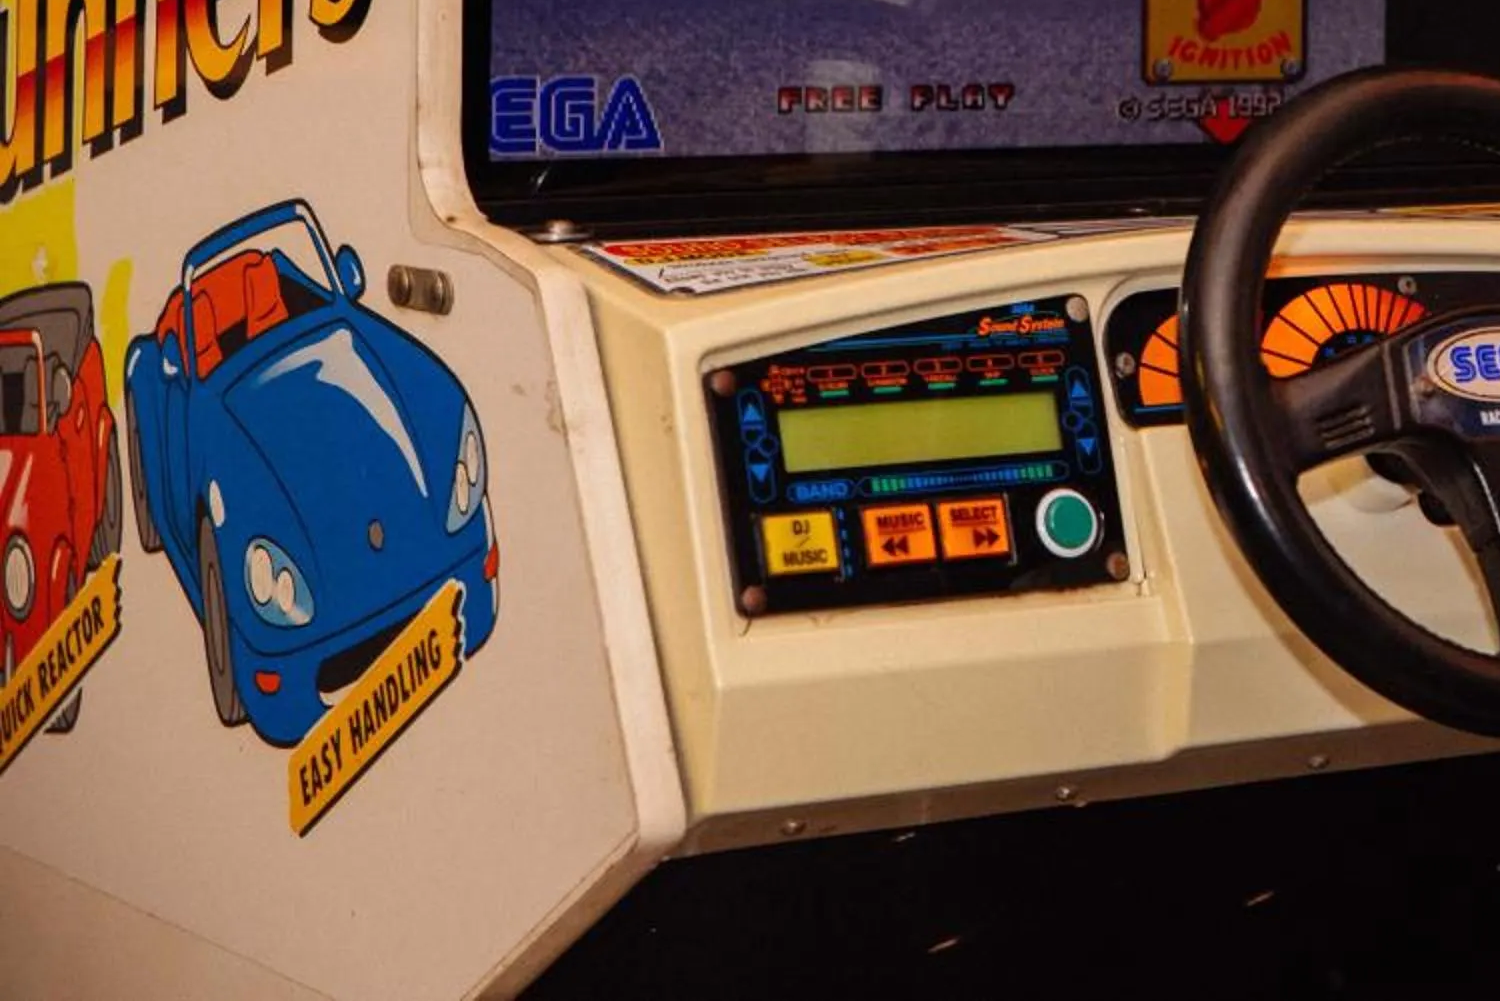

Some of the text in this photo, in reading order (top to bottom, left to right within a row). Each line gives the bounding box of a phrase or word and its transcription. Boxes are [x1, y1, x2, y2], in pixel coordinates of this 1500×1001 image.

[1166, 30, 1292, 72] IGNITION
[776, 82, 1017, 114] FREE PLAY
[977, 316, 1018, 337] Sound
[795, 481, 847, 499] BAND
[876, 511, 925, 528] MUSIC
[950, 505, 997, 522] SELECT
[791, 519, 810, 536] DJ
[782, 549, 828, 567] MUSIC
[0, 596, 105, 756] UICK REACTOR
[299, 628, 442, 807] EASY HANDLING
